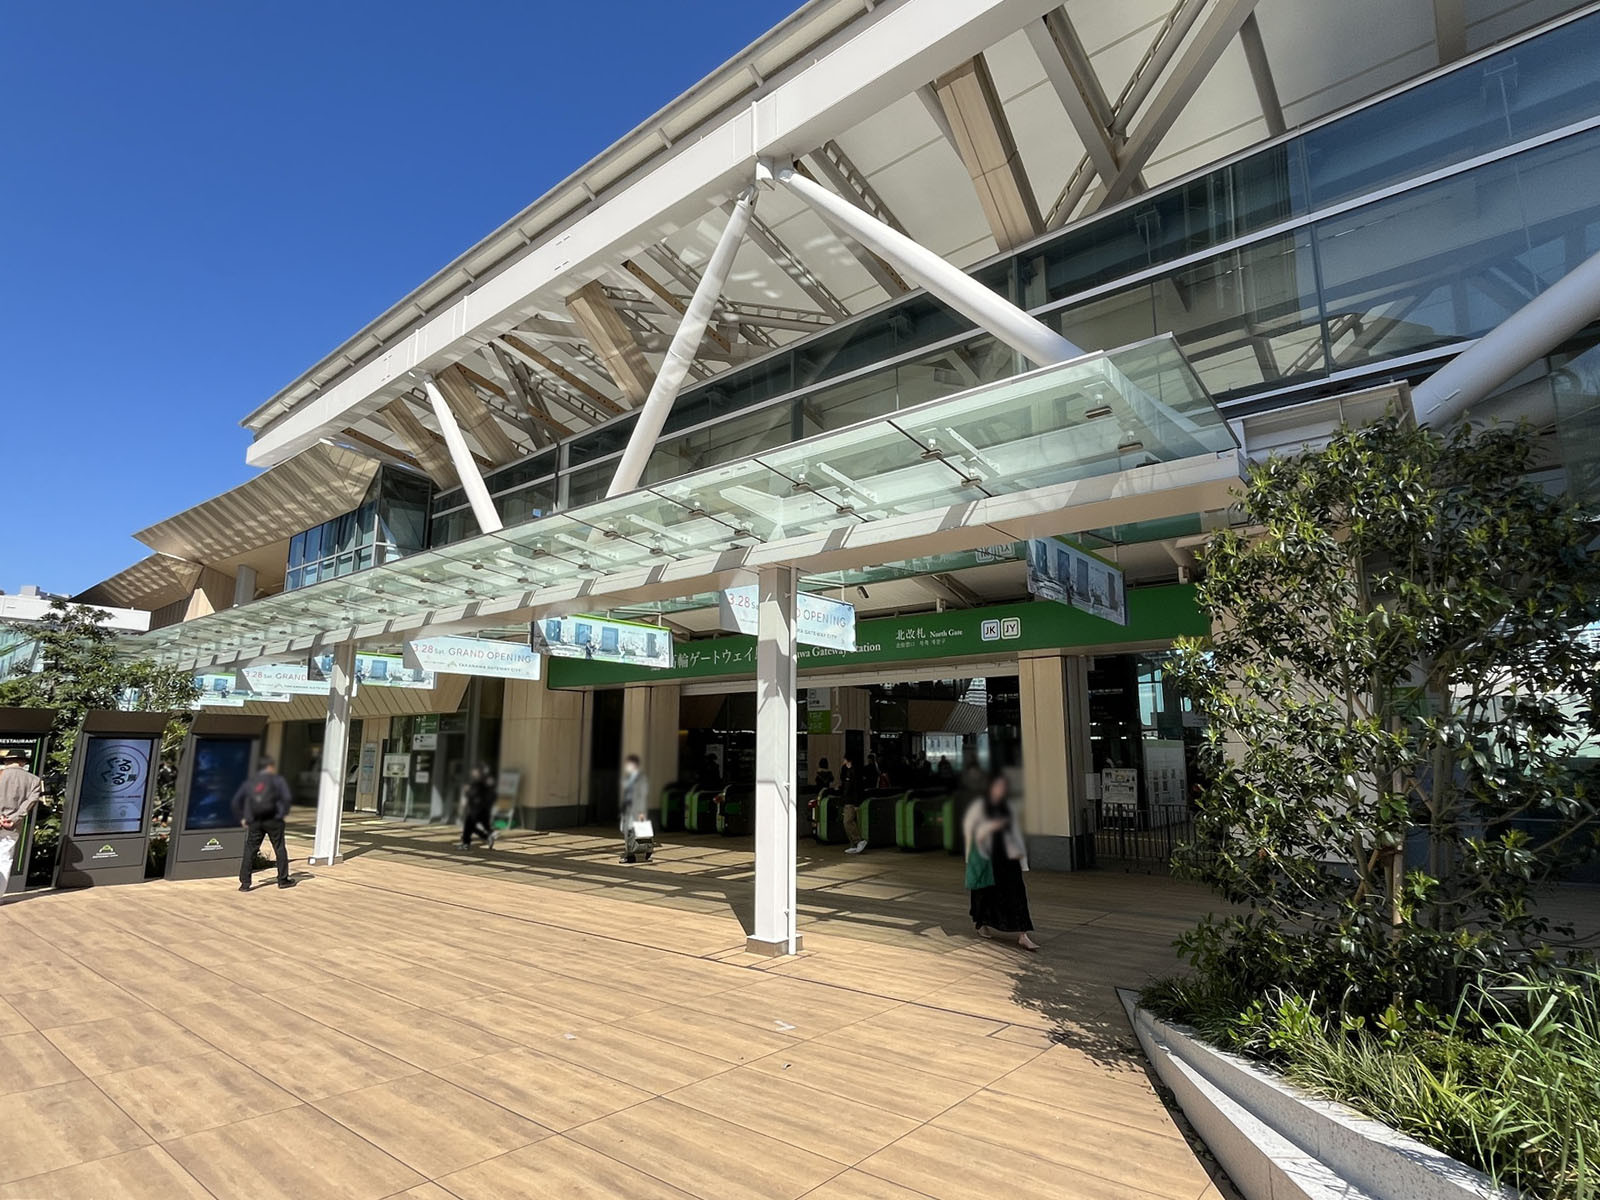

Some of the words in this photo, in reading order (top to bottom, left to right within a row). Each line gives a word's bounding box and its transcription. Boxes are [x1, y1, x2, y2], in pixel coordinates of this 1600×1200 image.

[803, 609, 846, 628] OPENING
[896, 627, 926, 641] 北改札
[929, 630, 948, 639] North
[948, 628, 963, 637] Gate
[985, 625, 996, 635] JK
[1006, 624, 1016, 633] JY
[448, 647, 485, 660] GRAND
[486, 651, 532, 664] OPENING
[673, 646, 758, 669] 輪ゲートウェイ
[811, 646, 847, 658] Gateway
[850, 642, 881, 654] tation
[275, 672, 306, 681] GRAND
